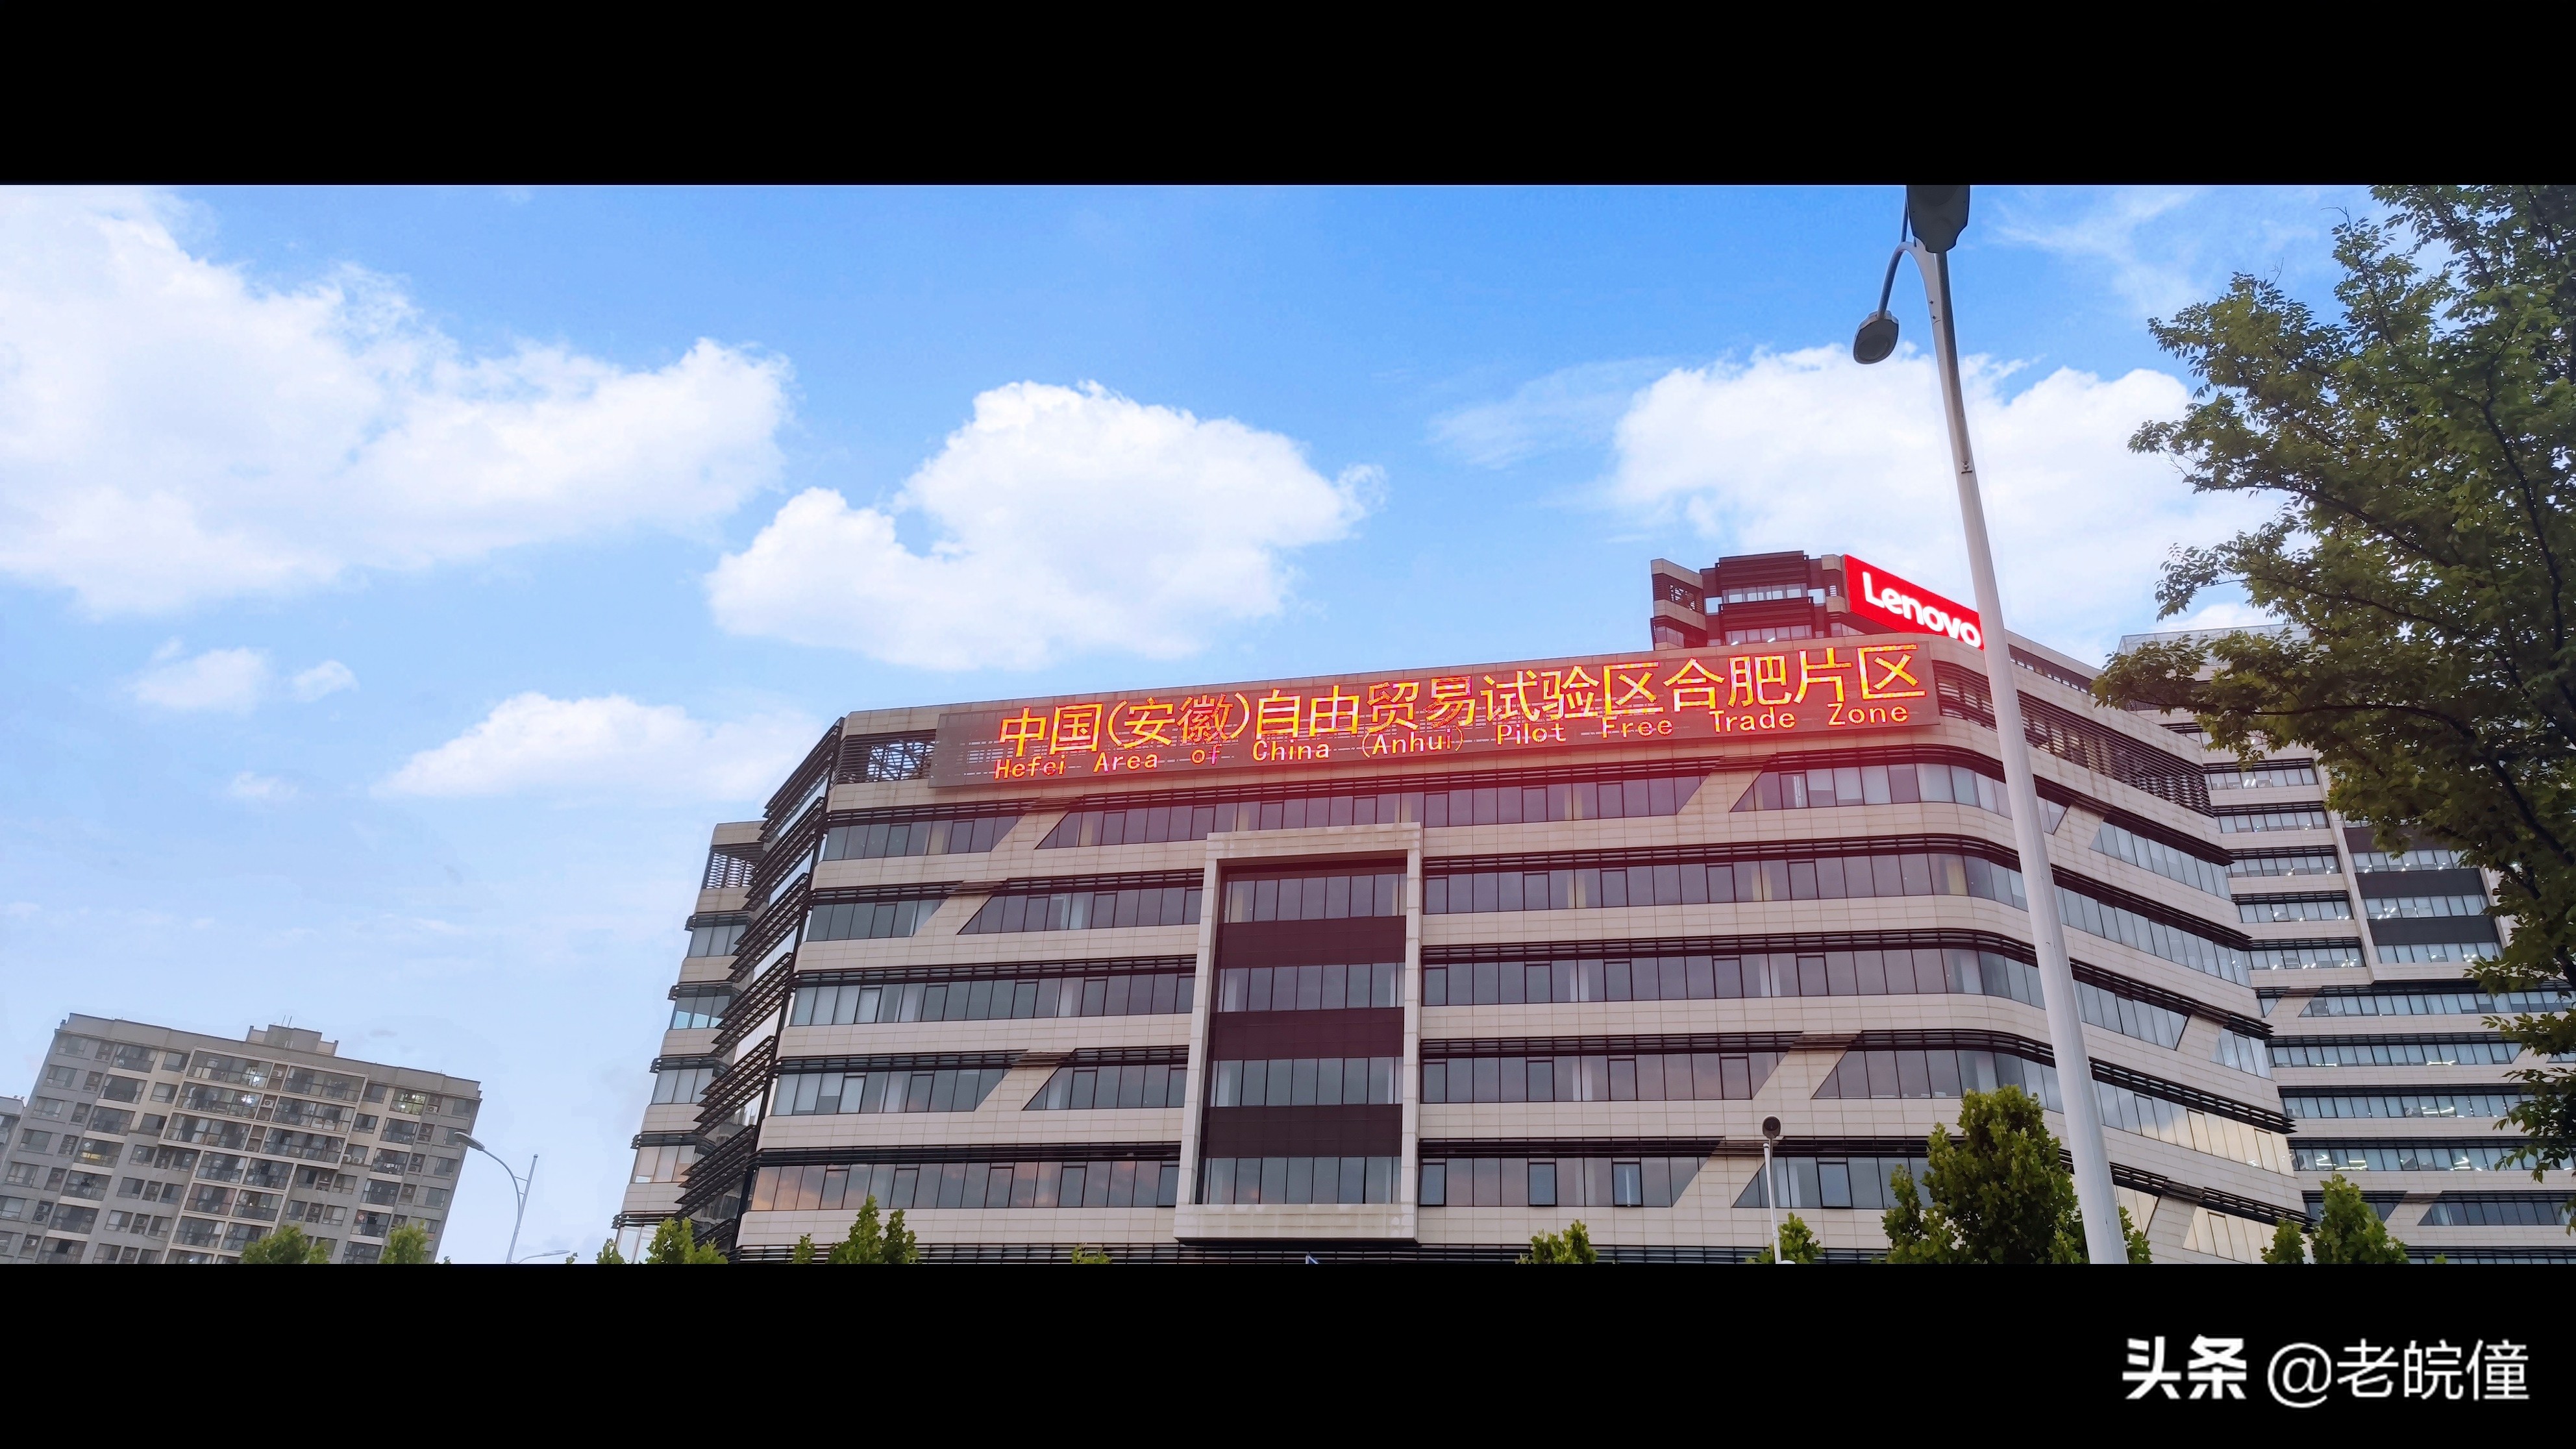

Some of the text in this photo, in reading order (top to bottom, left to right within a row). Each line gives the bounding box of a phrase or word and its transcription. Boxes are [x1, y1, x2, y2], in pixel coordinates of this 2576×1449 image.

[1862, 571, 1981, 649] Lenovo
[994, 702, 1909, 780] Hefei Area of China (Anhui) Pilot Free Trade Zone
